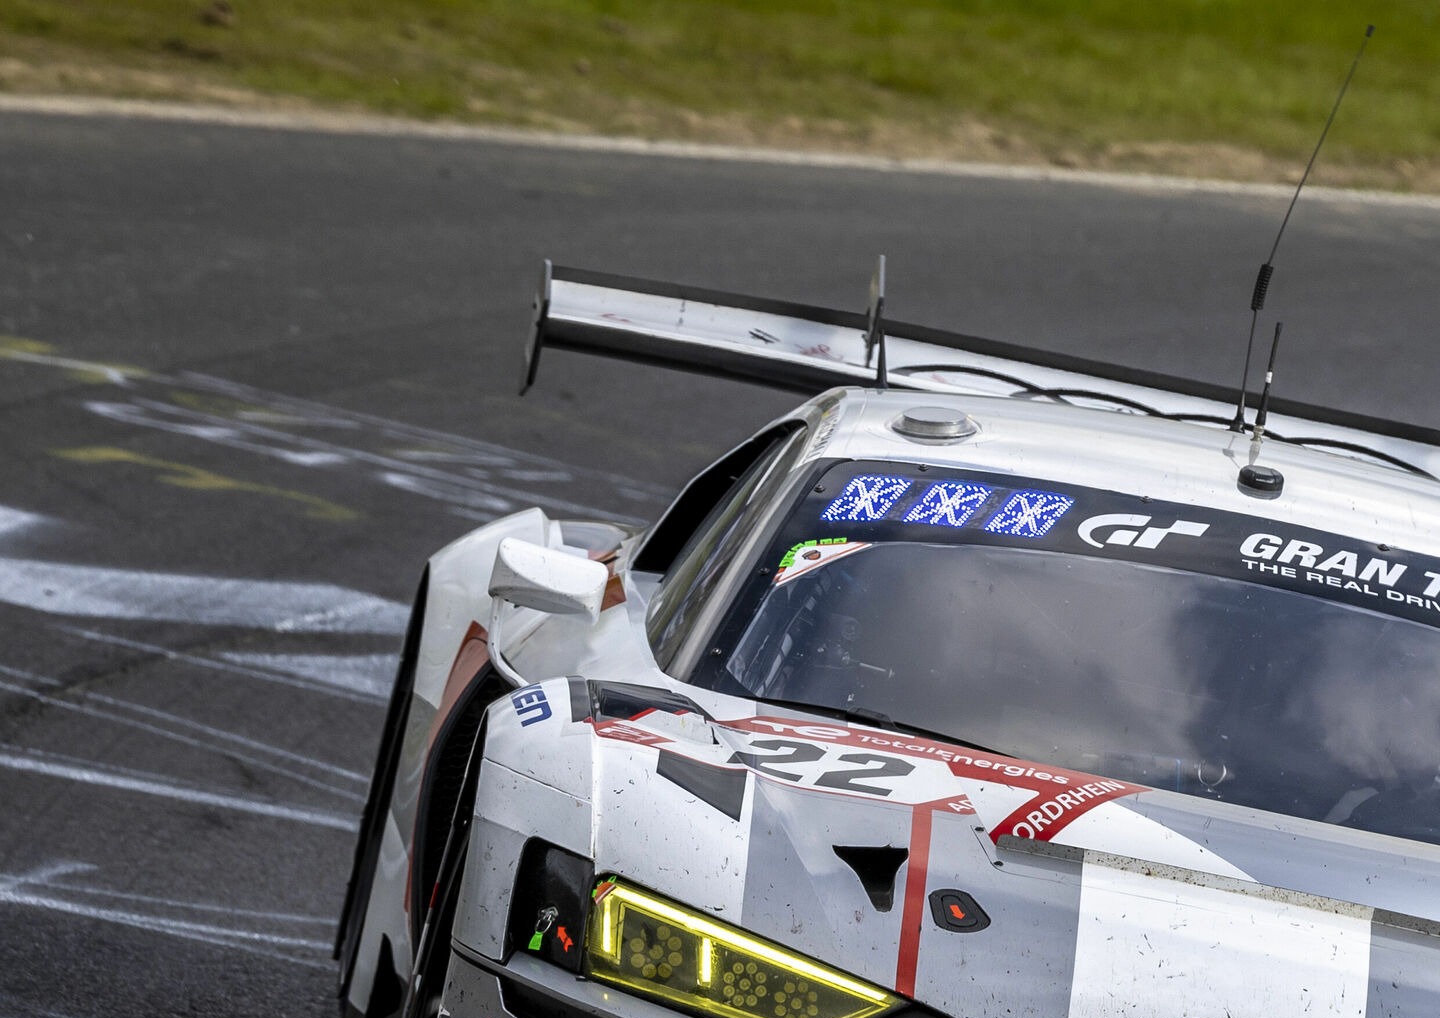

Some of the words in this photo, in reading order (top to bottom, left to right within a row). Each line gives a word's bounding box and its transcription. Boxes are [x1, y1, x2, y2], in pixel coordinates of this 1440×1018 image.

[1239, 533, 1408, 587] GRAN
[1241, 559, 1297, 578] THE
[1306, 571, 1379, 597] REAL
[726, 739, 916, 797] 22
[857, 734, 1070, 785] TotalEnergies
